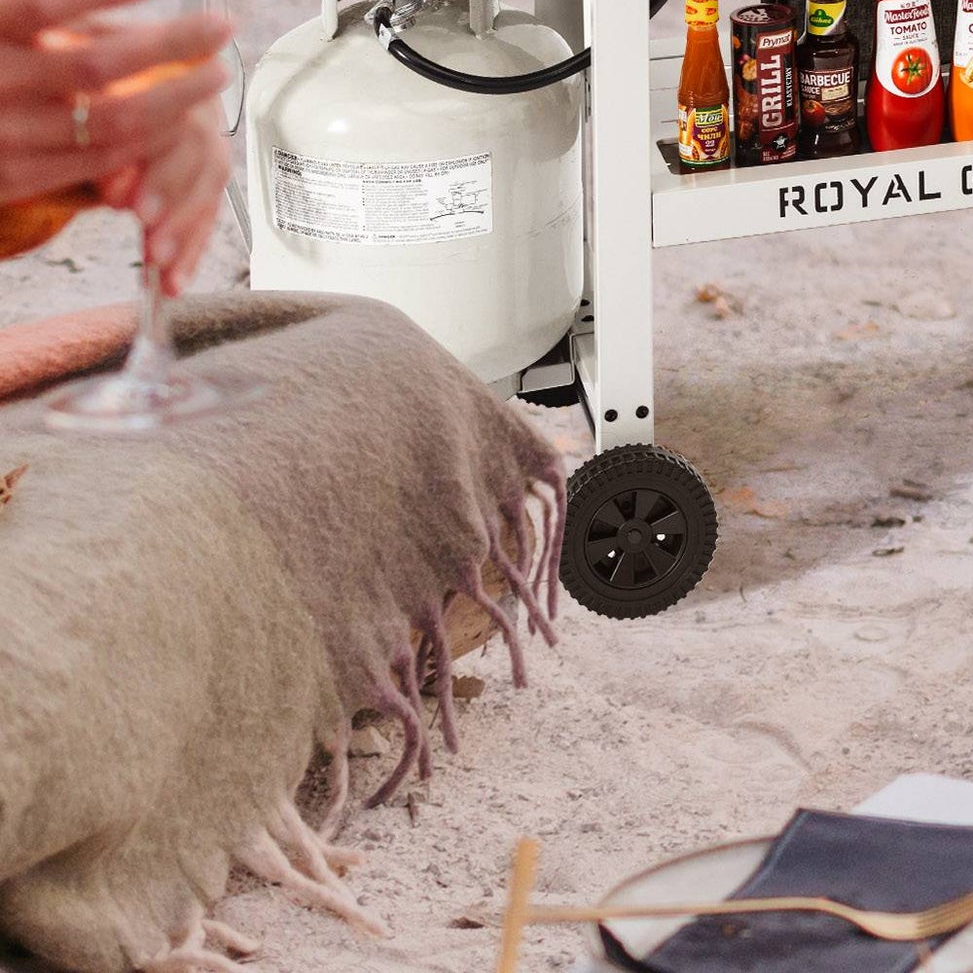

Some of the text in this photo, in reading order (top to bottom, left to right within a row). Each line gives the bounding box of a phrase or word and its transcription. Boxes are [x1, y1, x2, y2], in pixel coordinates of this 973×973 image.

[762, 33, 791, 48] Prymat
[890, 22, 927, 35] TOMATO
[761, 54, 782, 128] GRILL
[778, 170, 942, 218] ROYAL
